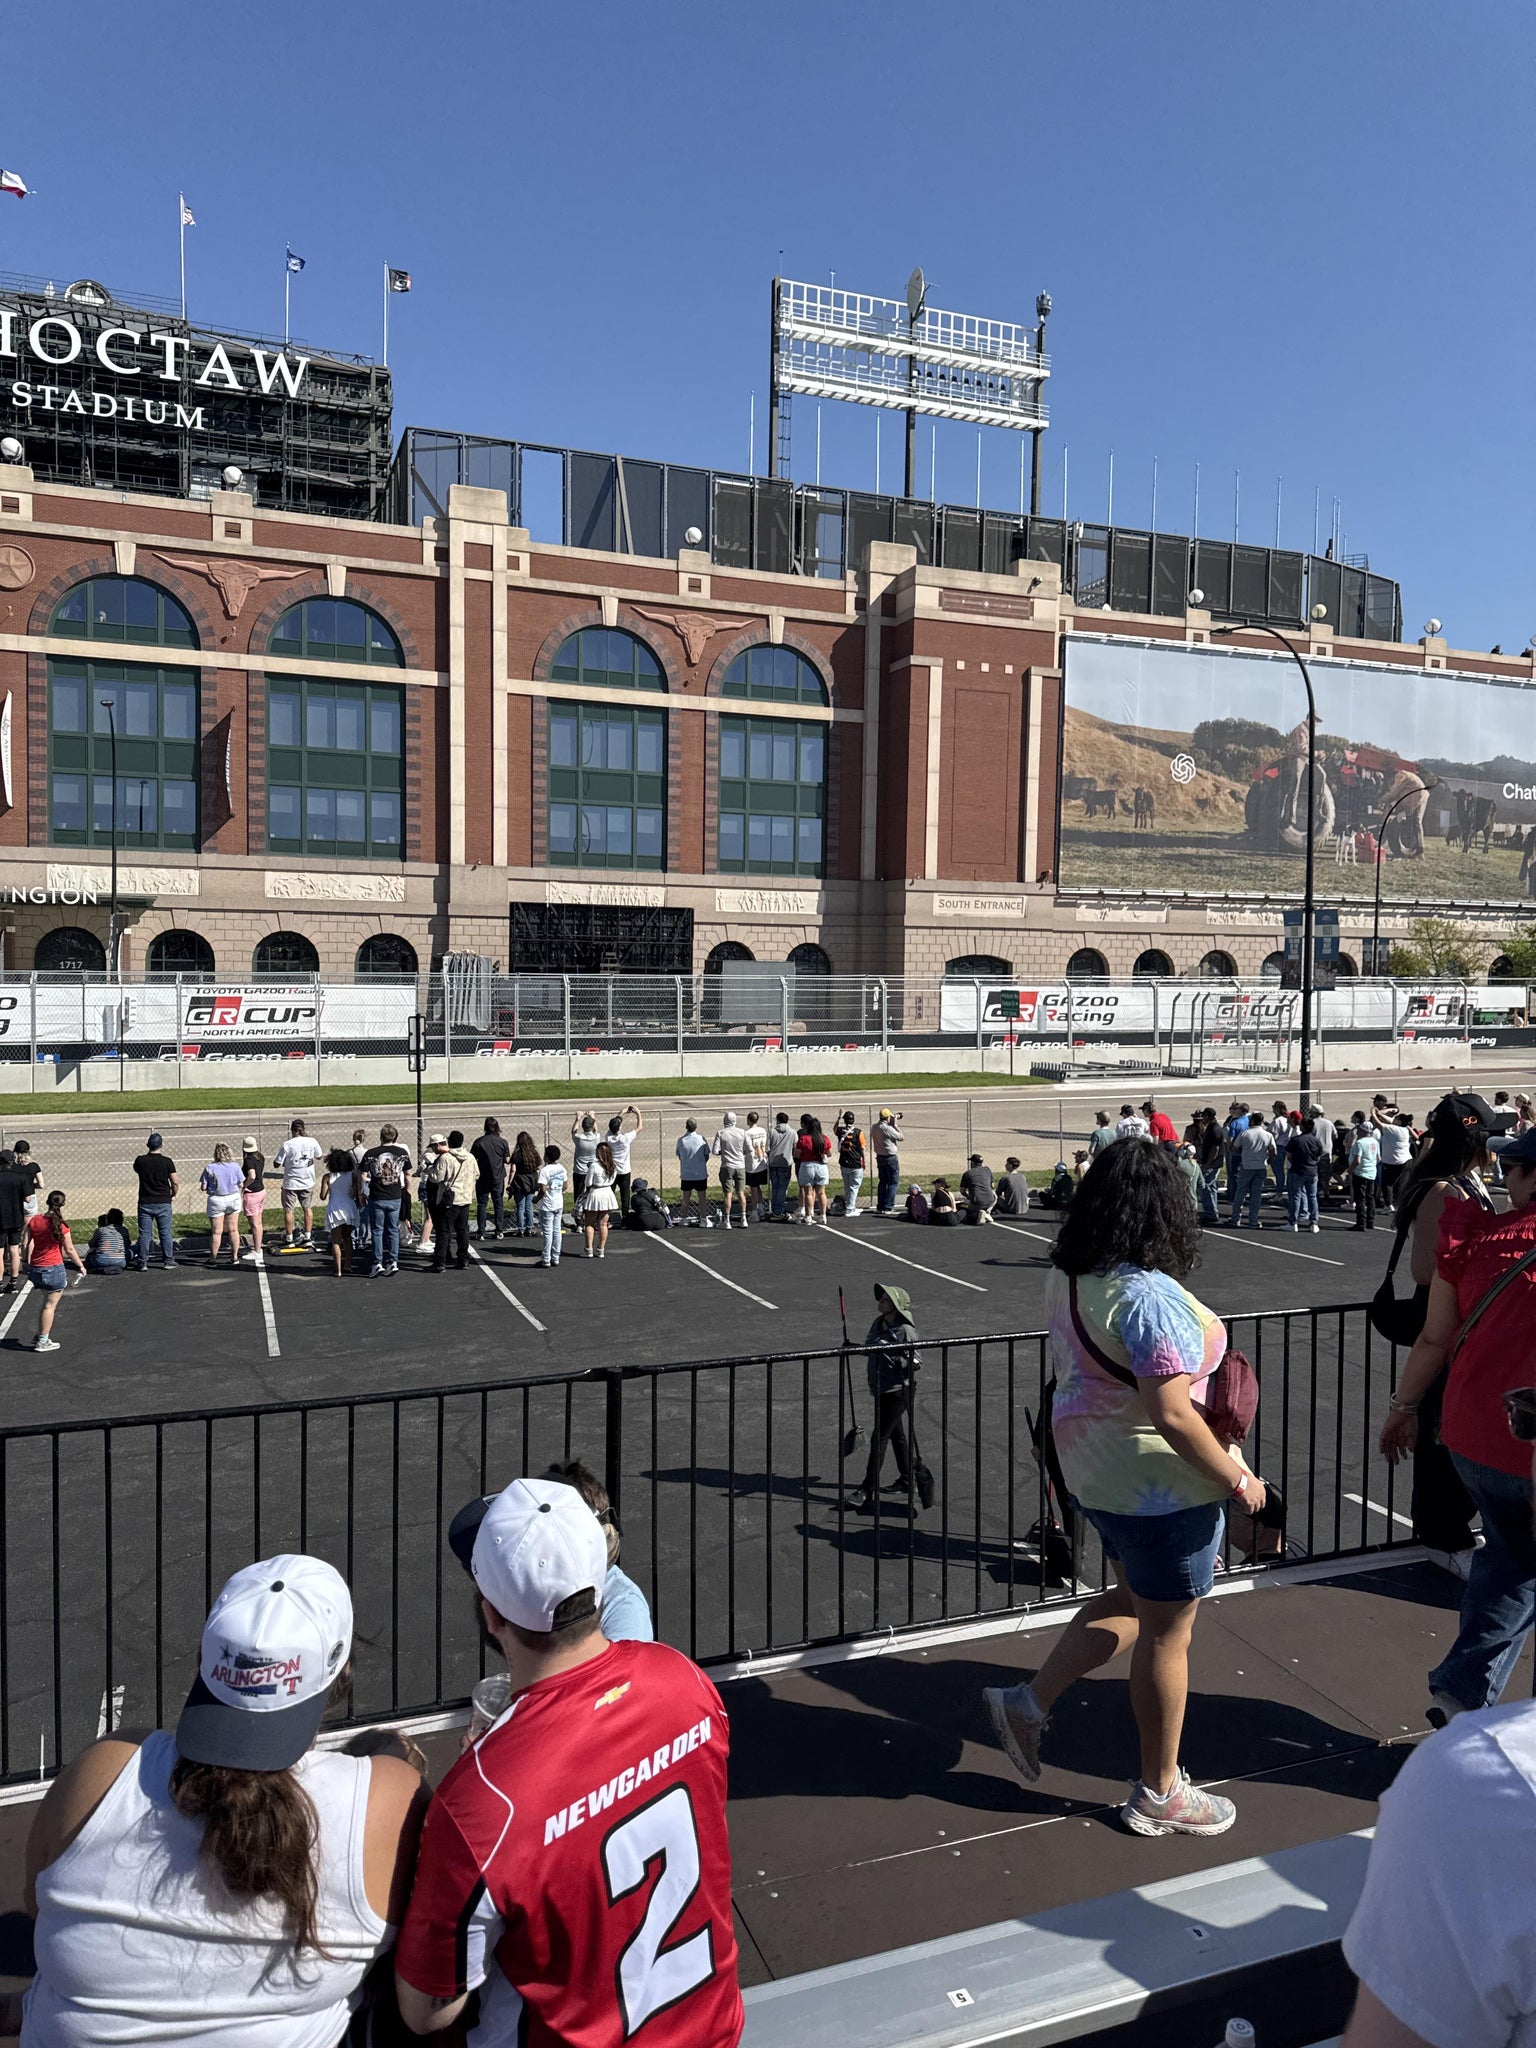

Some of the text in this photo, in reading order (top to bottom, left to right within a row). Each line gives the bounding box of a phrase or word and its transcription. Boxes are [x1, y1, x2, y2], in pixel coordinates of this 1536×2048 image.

[11, 381, 205, 430] STADIUM
[938, 898, 1023, 910] SOUTH ENTRANCE
[59, 960, 83, 969] 1717
[1043, 994, 1119, 1007] GAZOO
[186, 1007, 317, 1024] GR CUP
[247, 1028, 299, 1036] AMERICA
[211, 1655, 301, 1687] ARLINGTON
[283, 1676, 303, 1696] T
[543, 1716, 712, 1846] NEWGARDEN
[600, 1780, 717, 2044] 2
